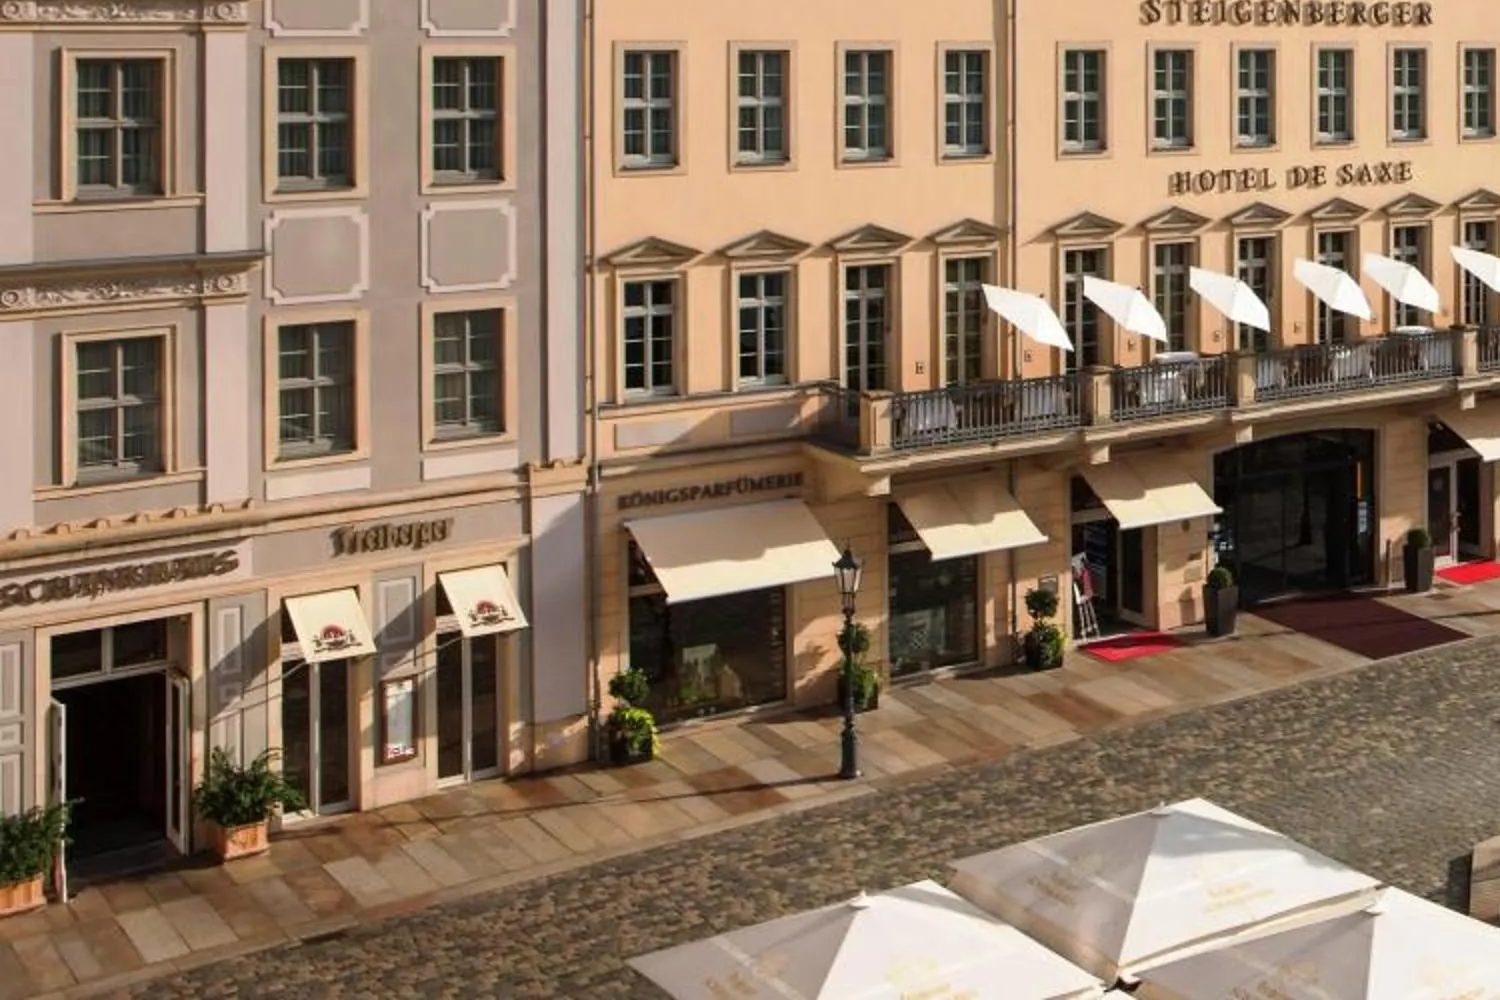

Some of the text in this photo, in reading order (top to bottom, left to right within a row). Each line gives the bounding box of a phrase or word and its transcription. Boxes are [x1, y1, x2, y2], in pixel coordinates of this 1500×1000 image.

[1169, 161, 1413, 196] HOTEL DE SAXE
[617, 471, 804, 511] KÖNIGSPARFÜMERIE
[329, 517, 454, 558] Freiberger
